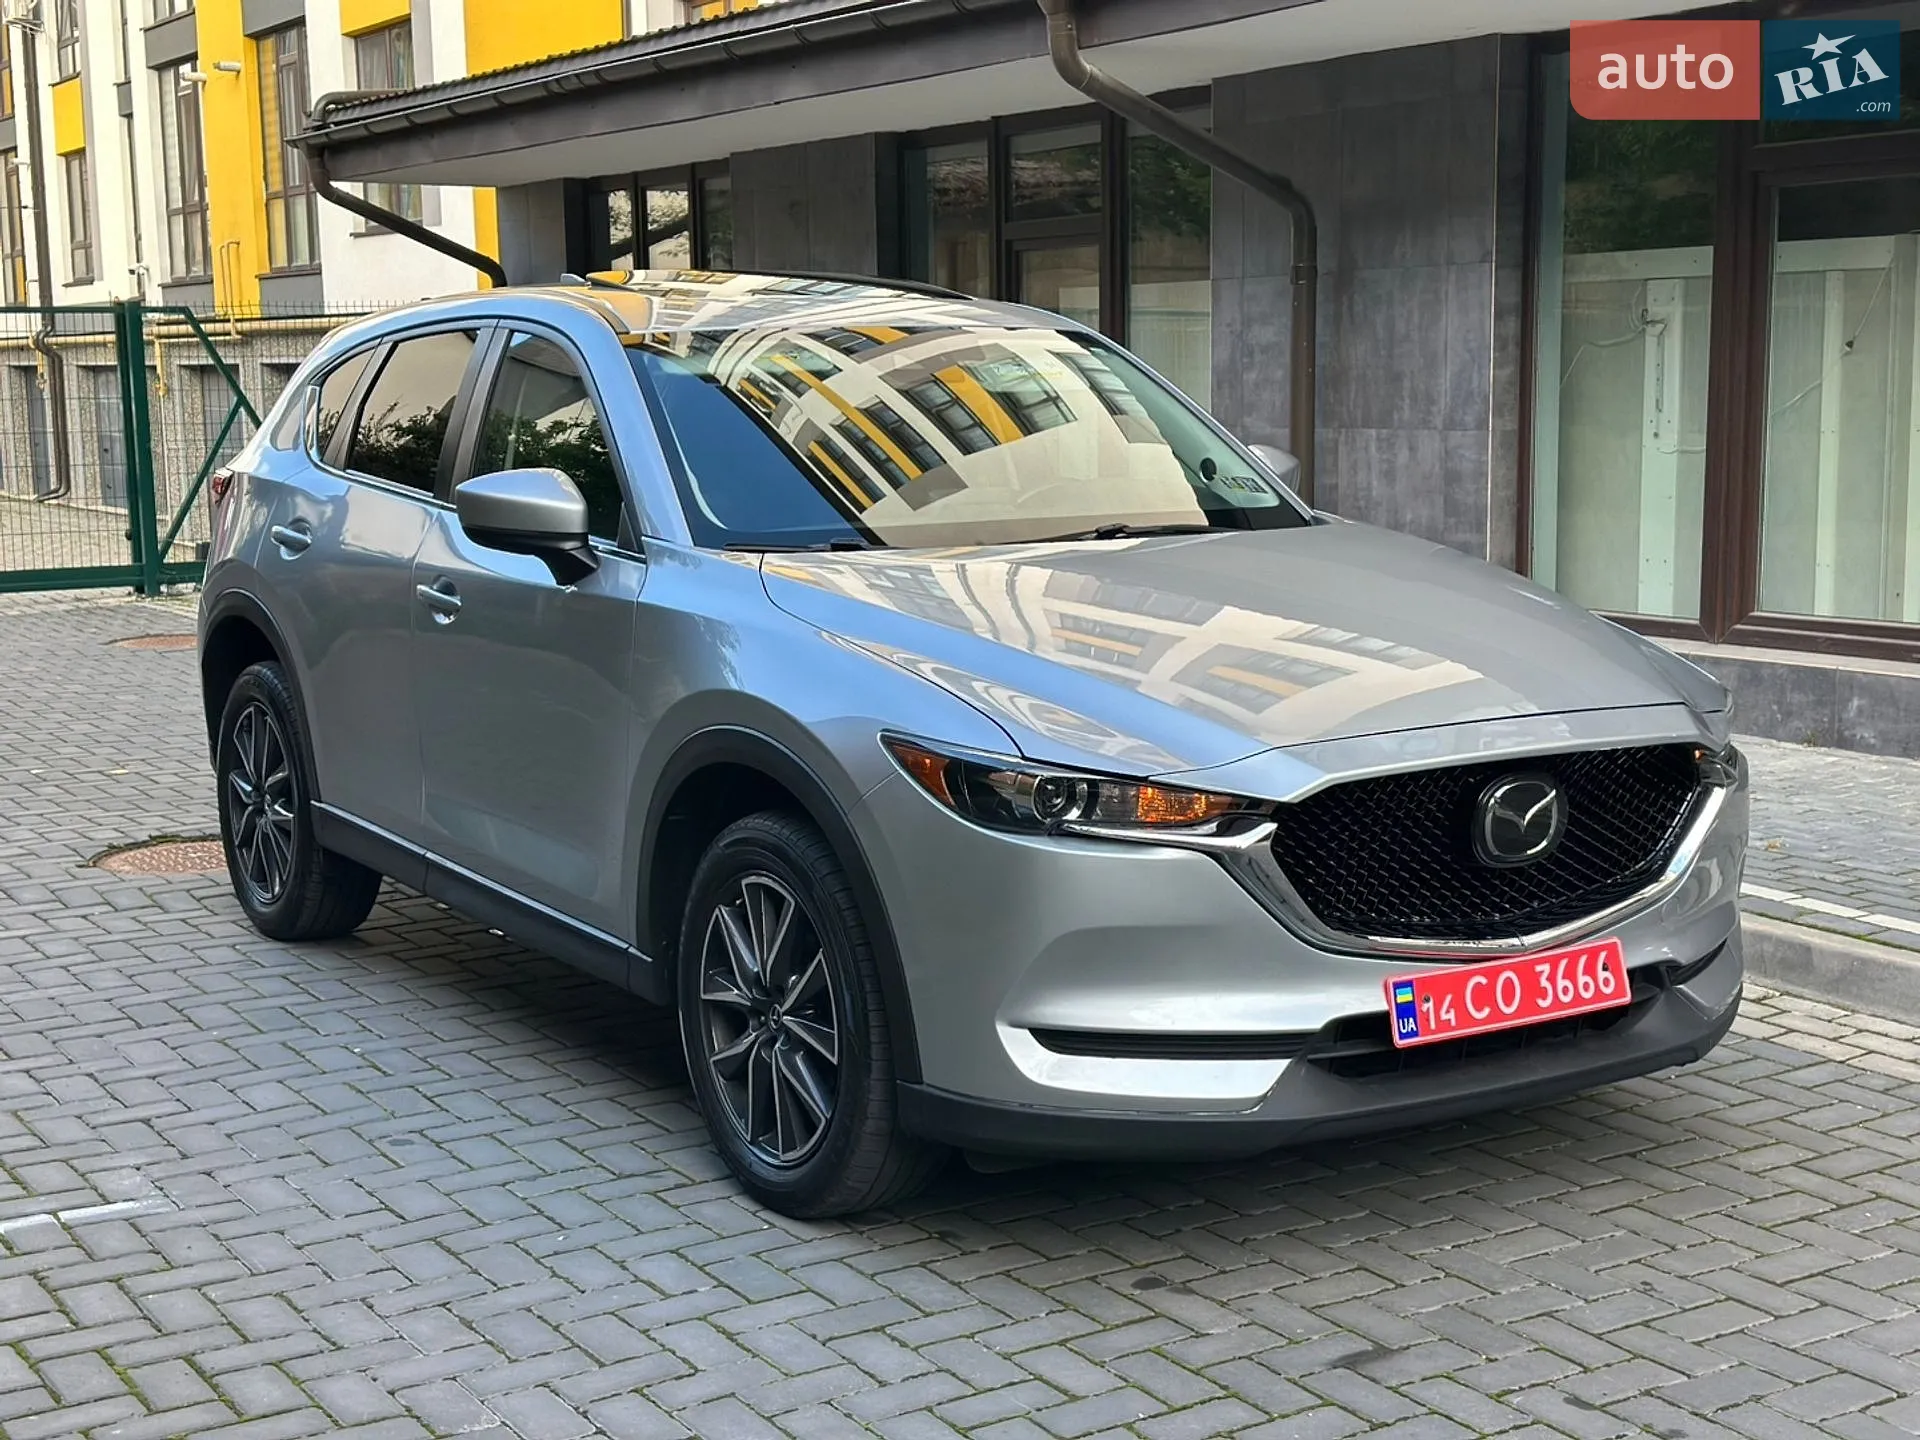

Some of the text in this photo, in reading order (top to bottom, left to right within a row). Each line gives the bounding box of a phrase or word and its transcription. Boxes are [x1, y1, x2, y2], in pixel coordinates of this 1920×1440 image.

[1421, 950, 1616, 1030] 14 CO 3666
[1399, 1017, 1417, 1034] UA
